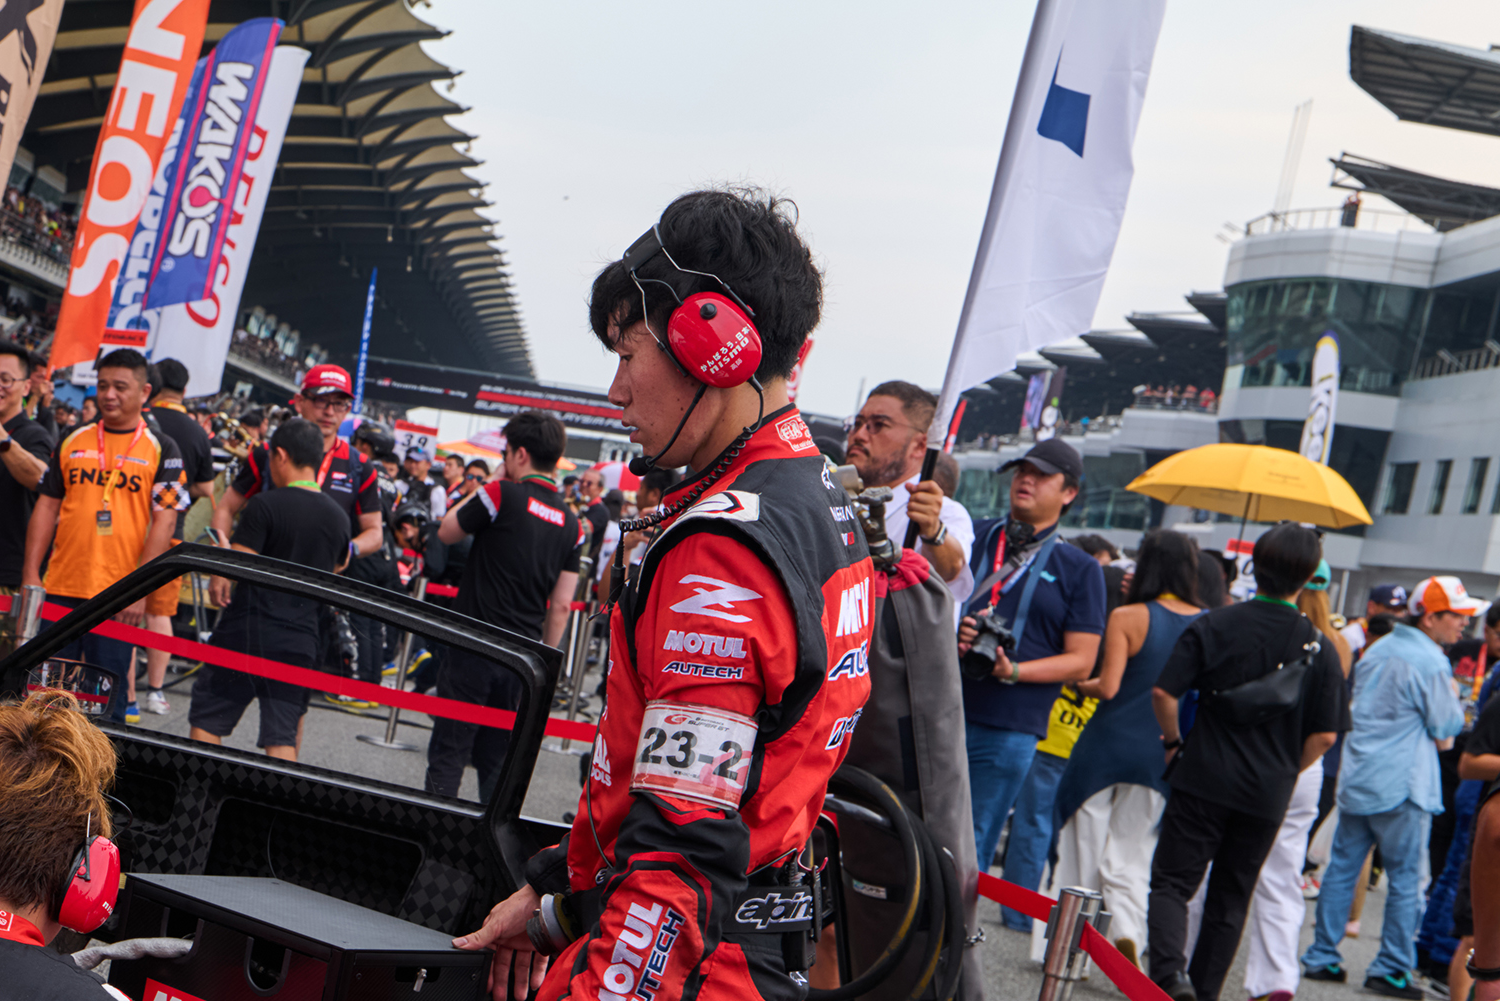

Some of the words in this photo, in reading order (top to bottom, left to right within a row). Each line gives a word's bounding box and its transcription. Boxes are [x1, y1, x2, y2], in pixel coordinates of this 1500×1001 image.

[710, 337, 749, 374] nismo
[530, 500, 564, 526] MOTUL
[663, 630, 747, 659] MOTUL
[662, 661, 744, 679] AUTECH
[640, 727, 743, 781] 23-2
